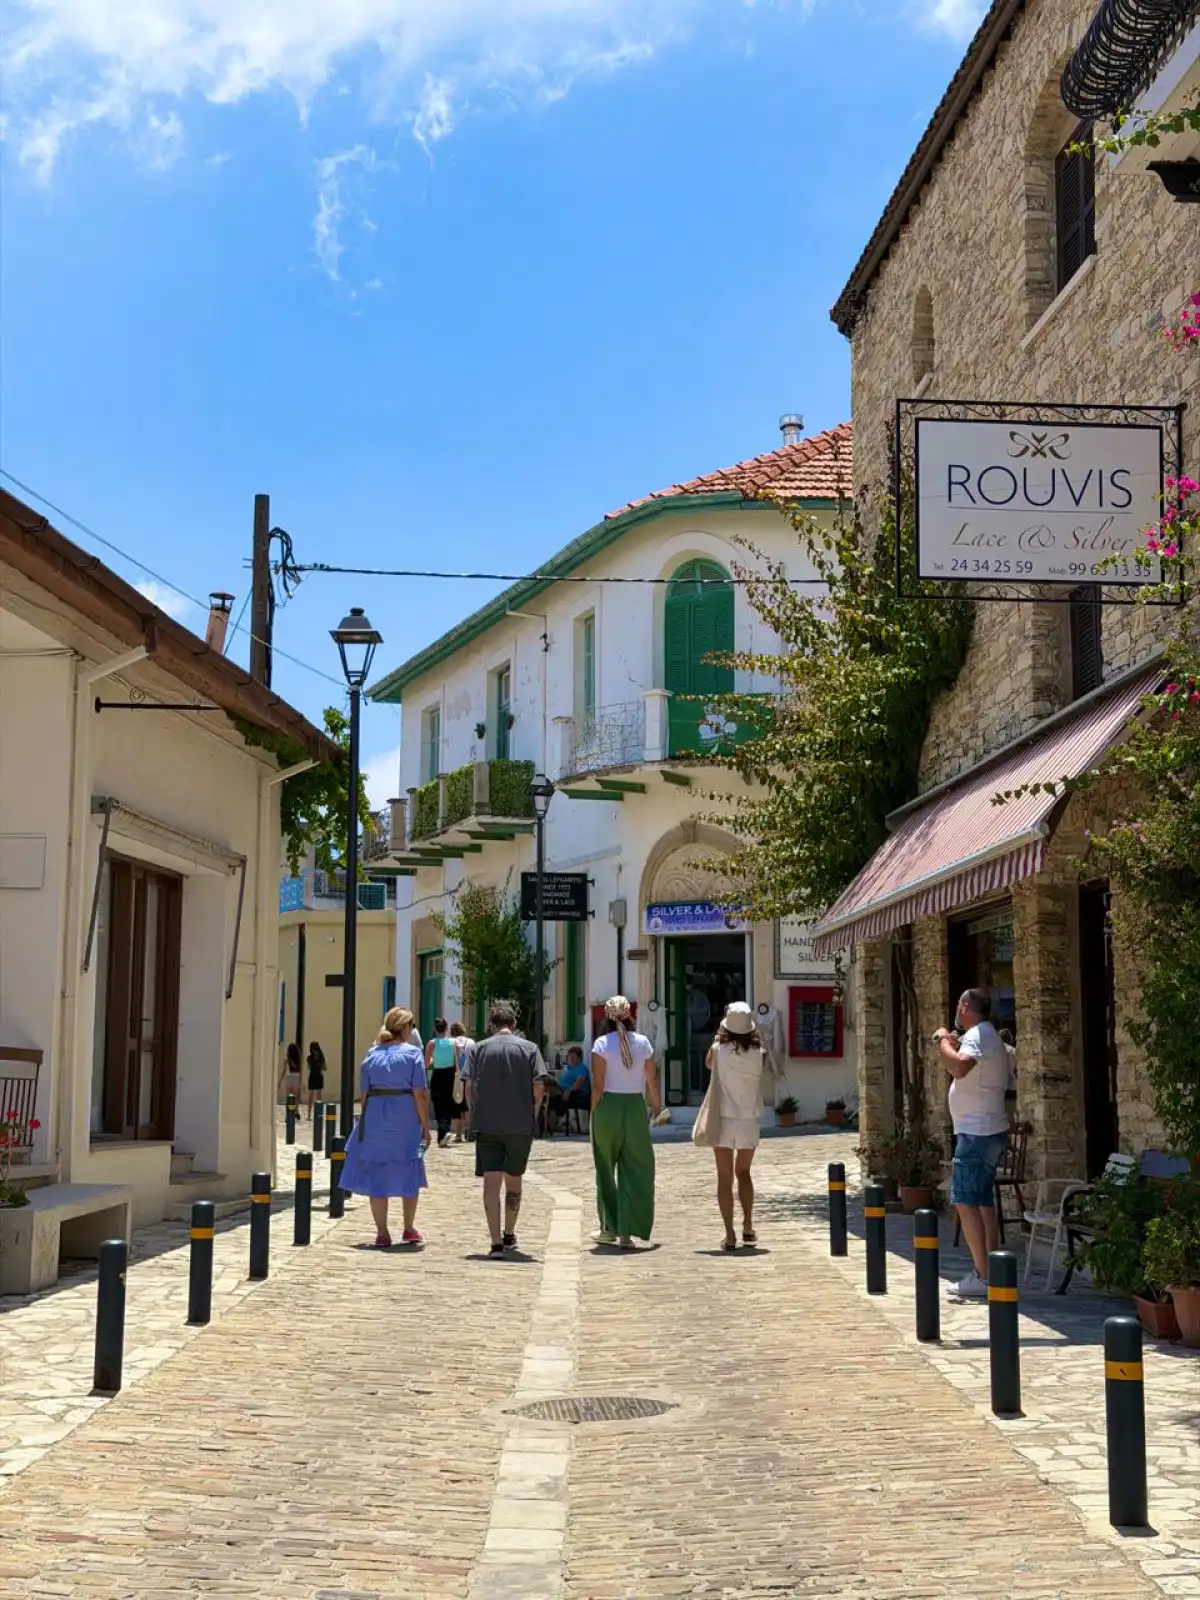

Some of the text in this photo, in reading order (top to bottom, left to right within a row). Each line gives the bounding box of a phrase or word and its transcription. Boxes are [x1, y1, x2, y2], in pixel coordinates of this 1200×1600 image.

[947, 464, 1133, 509] ROUVIS
[950, 516, 1134, 555] Lace & Silver
[950, 558, 968, 571] 24
[971, 558, 990, 572] 34
[993, 559, 1011, 573] 25
[1015, 560, 1034, 573] 59
[1069, 562, 1086, 575] 99
[651, 904, 693, 917] SILVER
[694, 904, 703, 916] &
[784, 936, 814, 947] HAND
